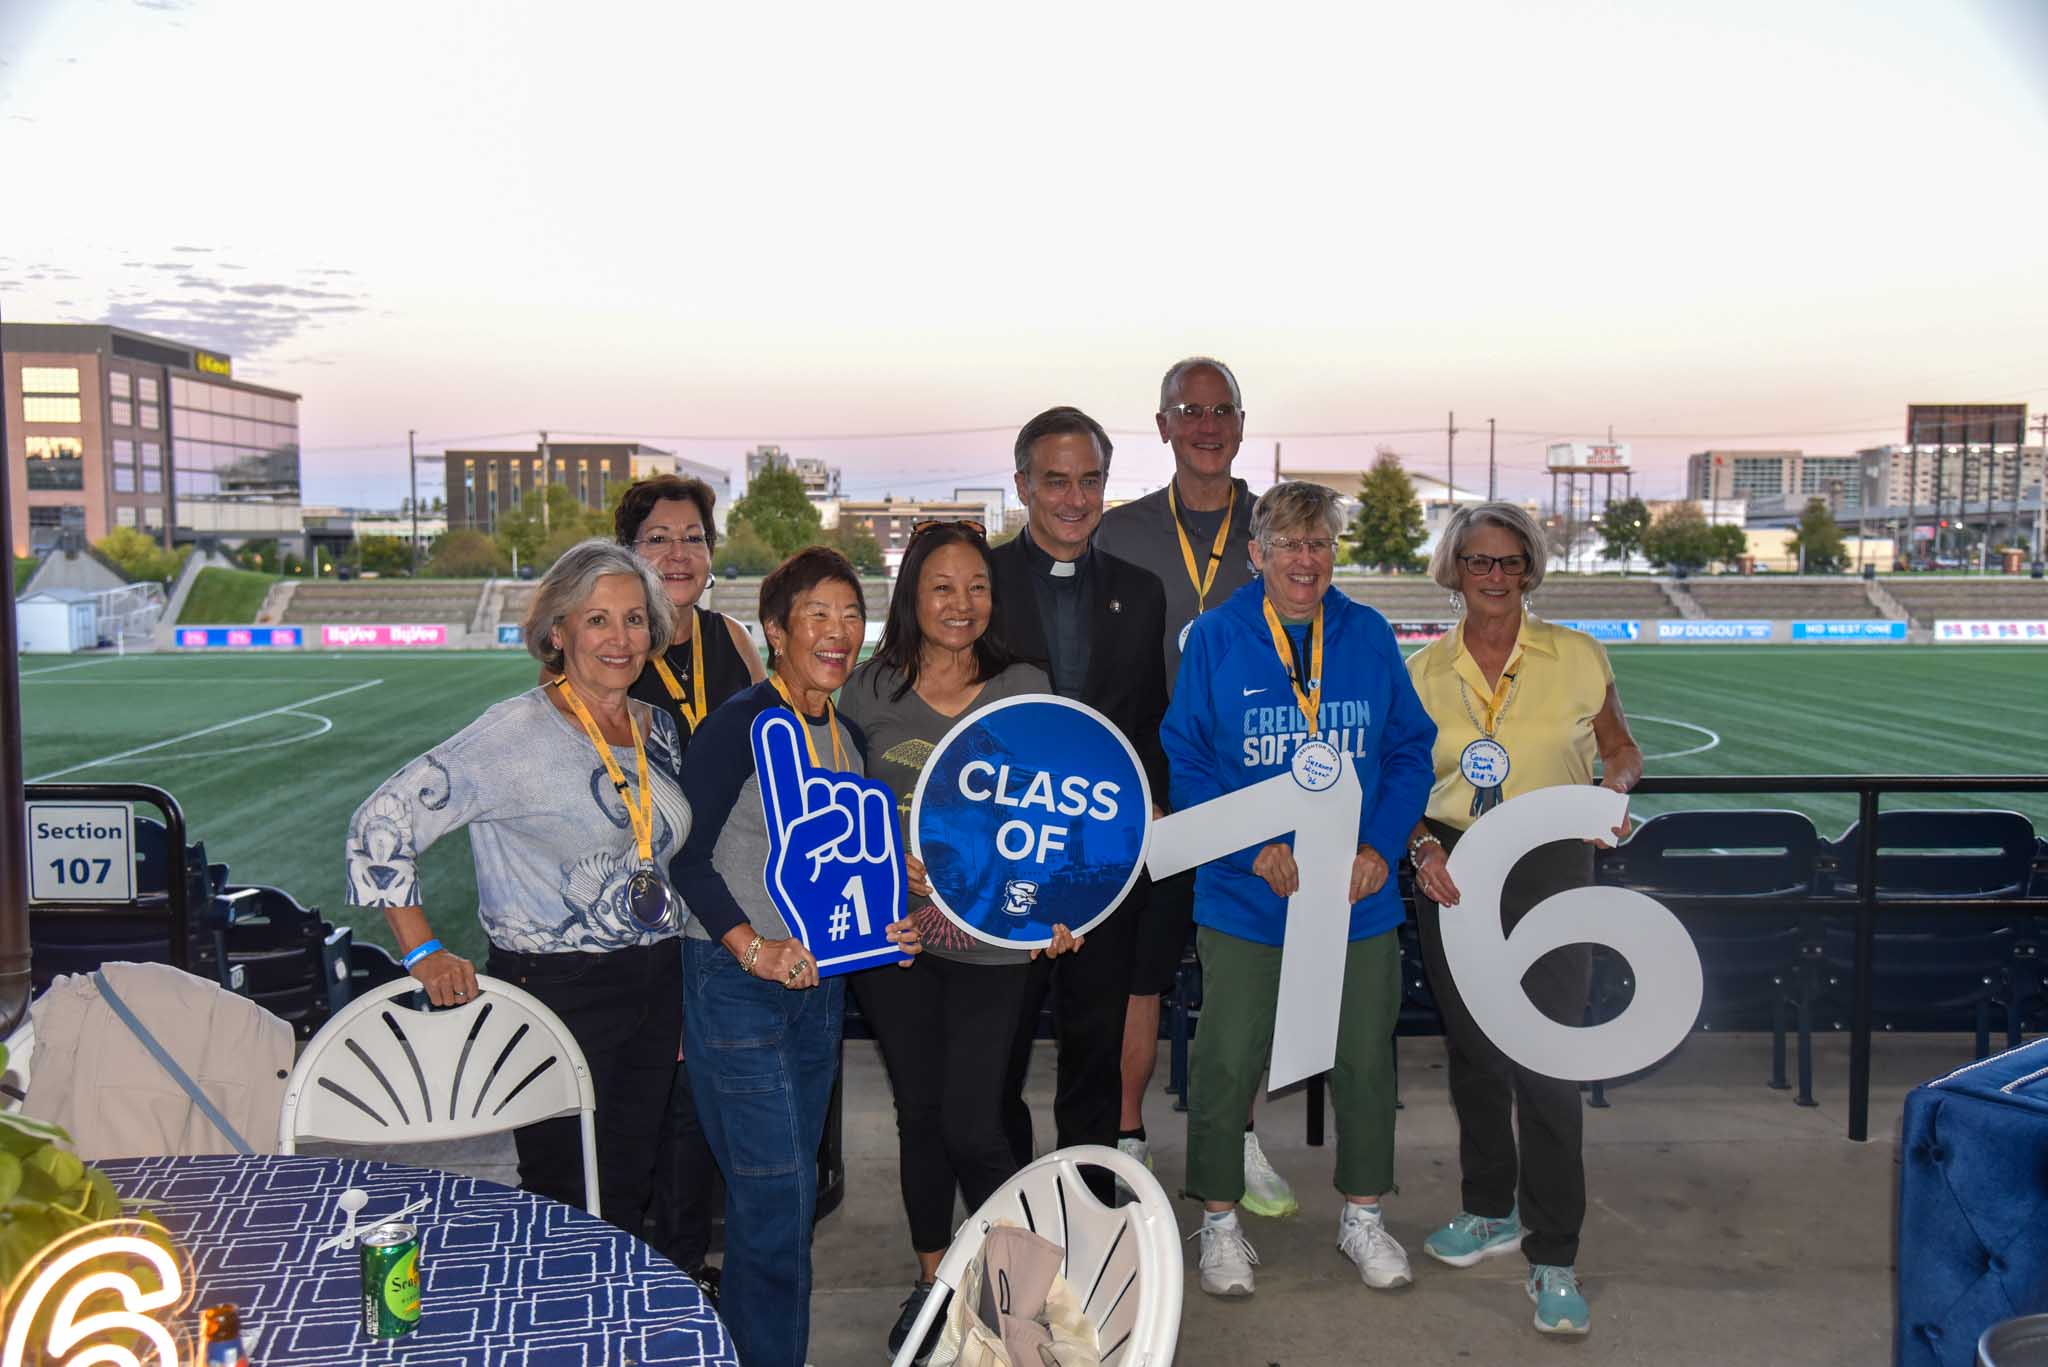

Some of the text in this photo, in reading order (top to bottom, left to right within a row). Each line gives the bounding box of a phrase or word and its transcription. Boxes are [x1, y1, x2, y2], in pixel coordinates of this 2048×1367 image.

[1243, 727, 1366, 767] SOFTALL
[958, 760, 1121, 822] CLASS
[37, 822, 122, 839] Section
[996, 820, 1068, 864] OF
[49, 857, 112, 885] 107
[828, 874, 872, 942] #1
